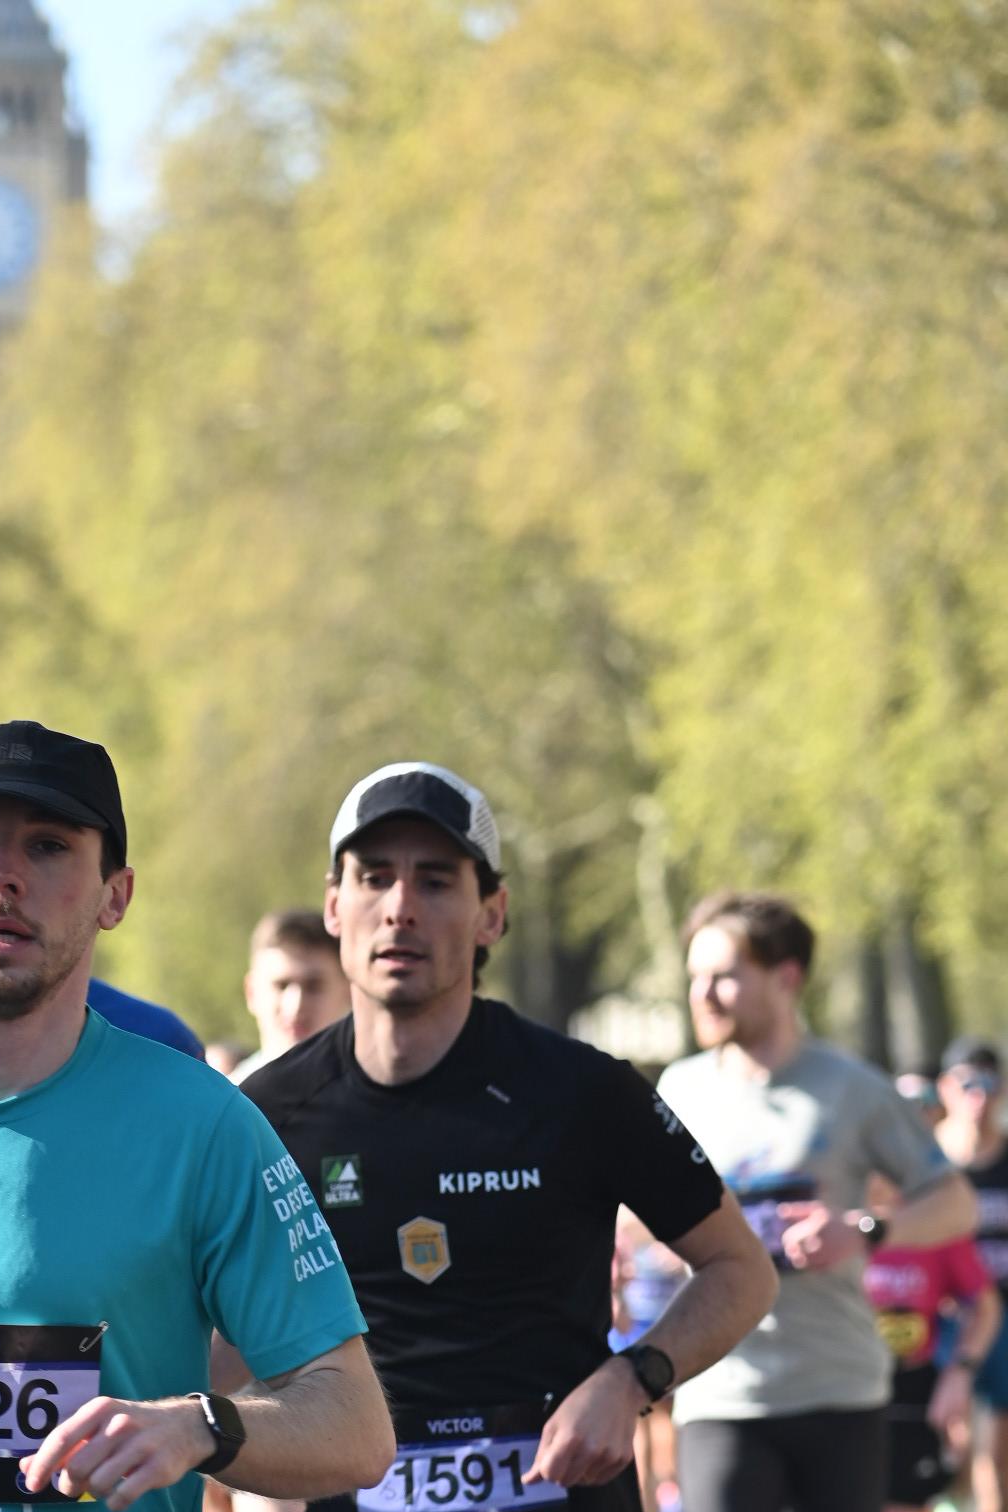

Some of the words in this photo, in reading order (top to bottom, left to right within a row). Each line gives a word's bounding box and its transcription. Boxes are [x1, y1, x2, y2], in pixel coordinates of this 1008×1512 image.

[438, 1168, 542, 1195] KIPRUN
[427, 1417, 485, 1435] VICTOR
[394, 1448, 525, 1506] 1591
